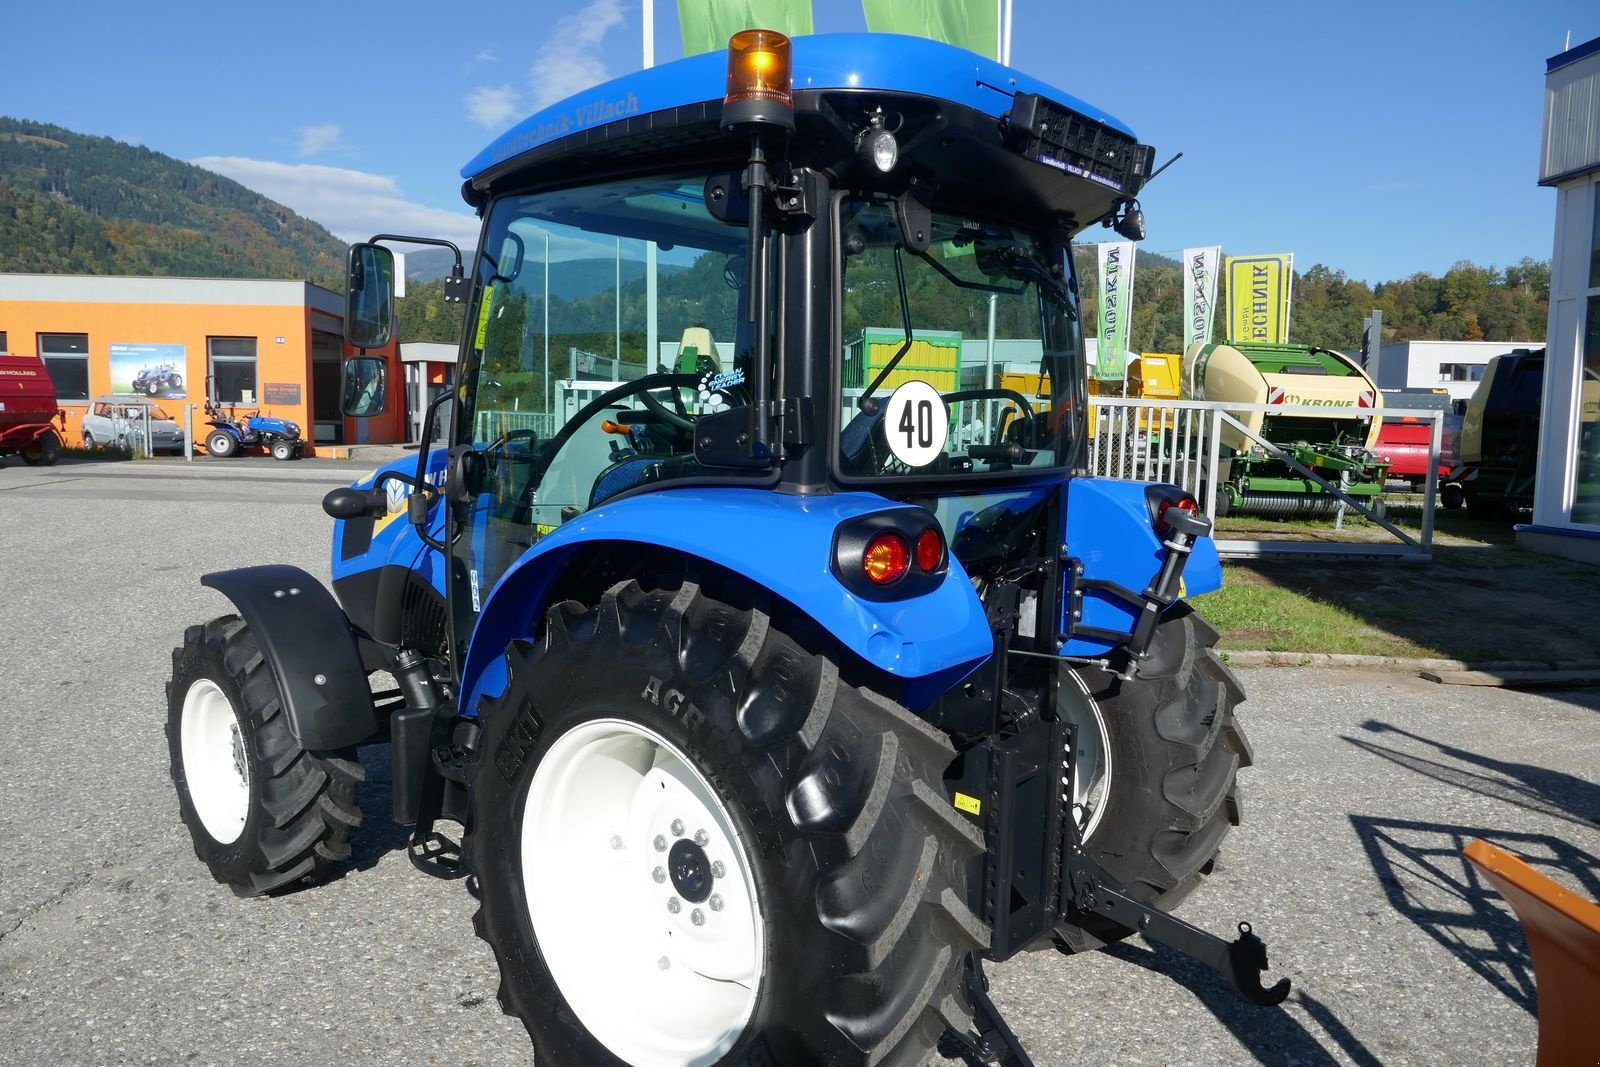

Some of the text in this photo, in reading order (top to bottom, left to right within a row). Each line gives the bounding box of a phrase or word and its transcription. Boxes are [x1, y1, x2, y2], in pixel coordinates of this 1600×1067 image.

[708, 371, 745, 388] ENERGY
[713, 367, 742, 381] CLEAN
[711, 377, 745, 391] LEADER
[1302, 398, 1354, 407] KRONE
[898, 400, 933, 448] 40
